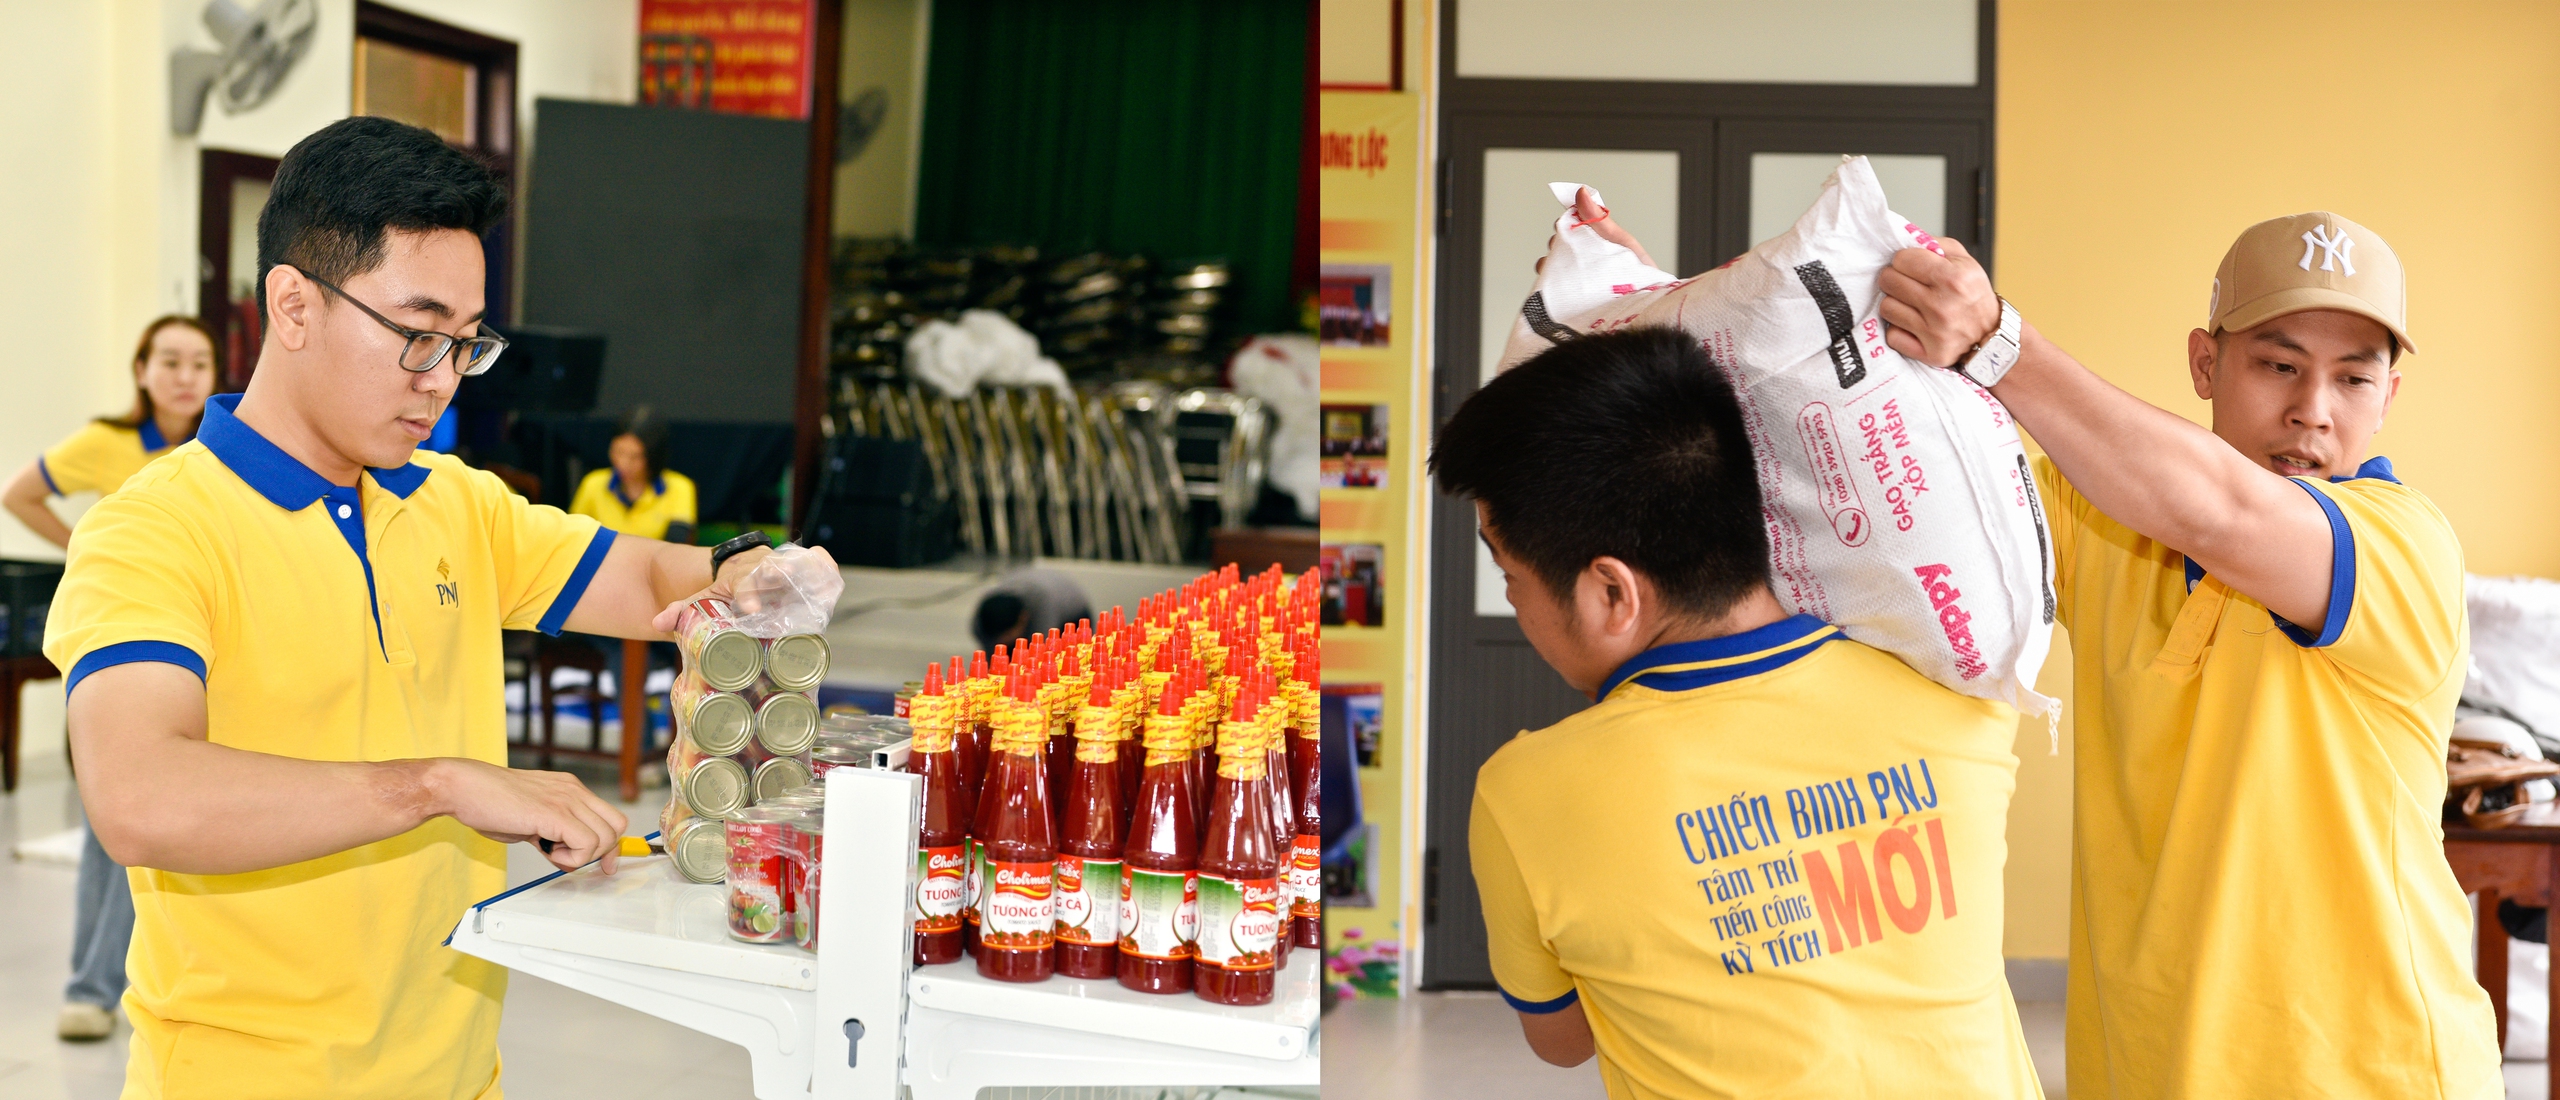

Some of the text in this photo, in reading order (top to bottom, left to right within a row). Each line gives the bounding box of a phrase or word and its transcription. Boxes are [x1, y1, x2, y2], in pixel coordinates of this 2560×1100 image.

[2298, 223, 2357, 278] NY
[1863, 317, 1885, 359] 5 kg
[1823, 442, 1838, 471] 3920
[1881, 398, 1929, 496] XỐP MỀM
[1833, 474, 1850, 503] (028)
[1858, 413, 1914, 532] GẠO TRẮNG
[435, 581, 459, 609] PNJ
[1866, 758, 1938, 819] PNJ
[996, 869, 1052, 884] Cholimex
[1758, 850, 1800, 890] TRÍ
[1800, 813, 1958, 955] MỚI
[925, 887, 962, 900] TƯƠNG
[993, 904, 1037, 917] TƯƠNG
[1066, 897, 1082, 911] CÀ
[1720, 929, 1822, 976] KỲ TÍCH
